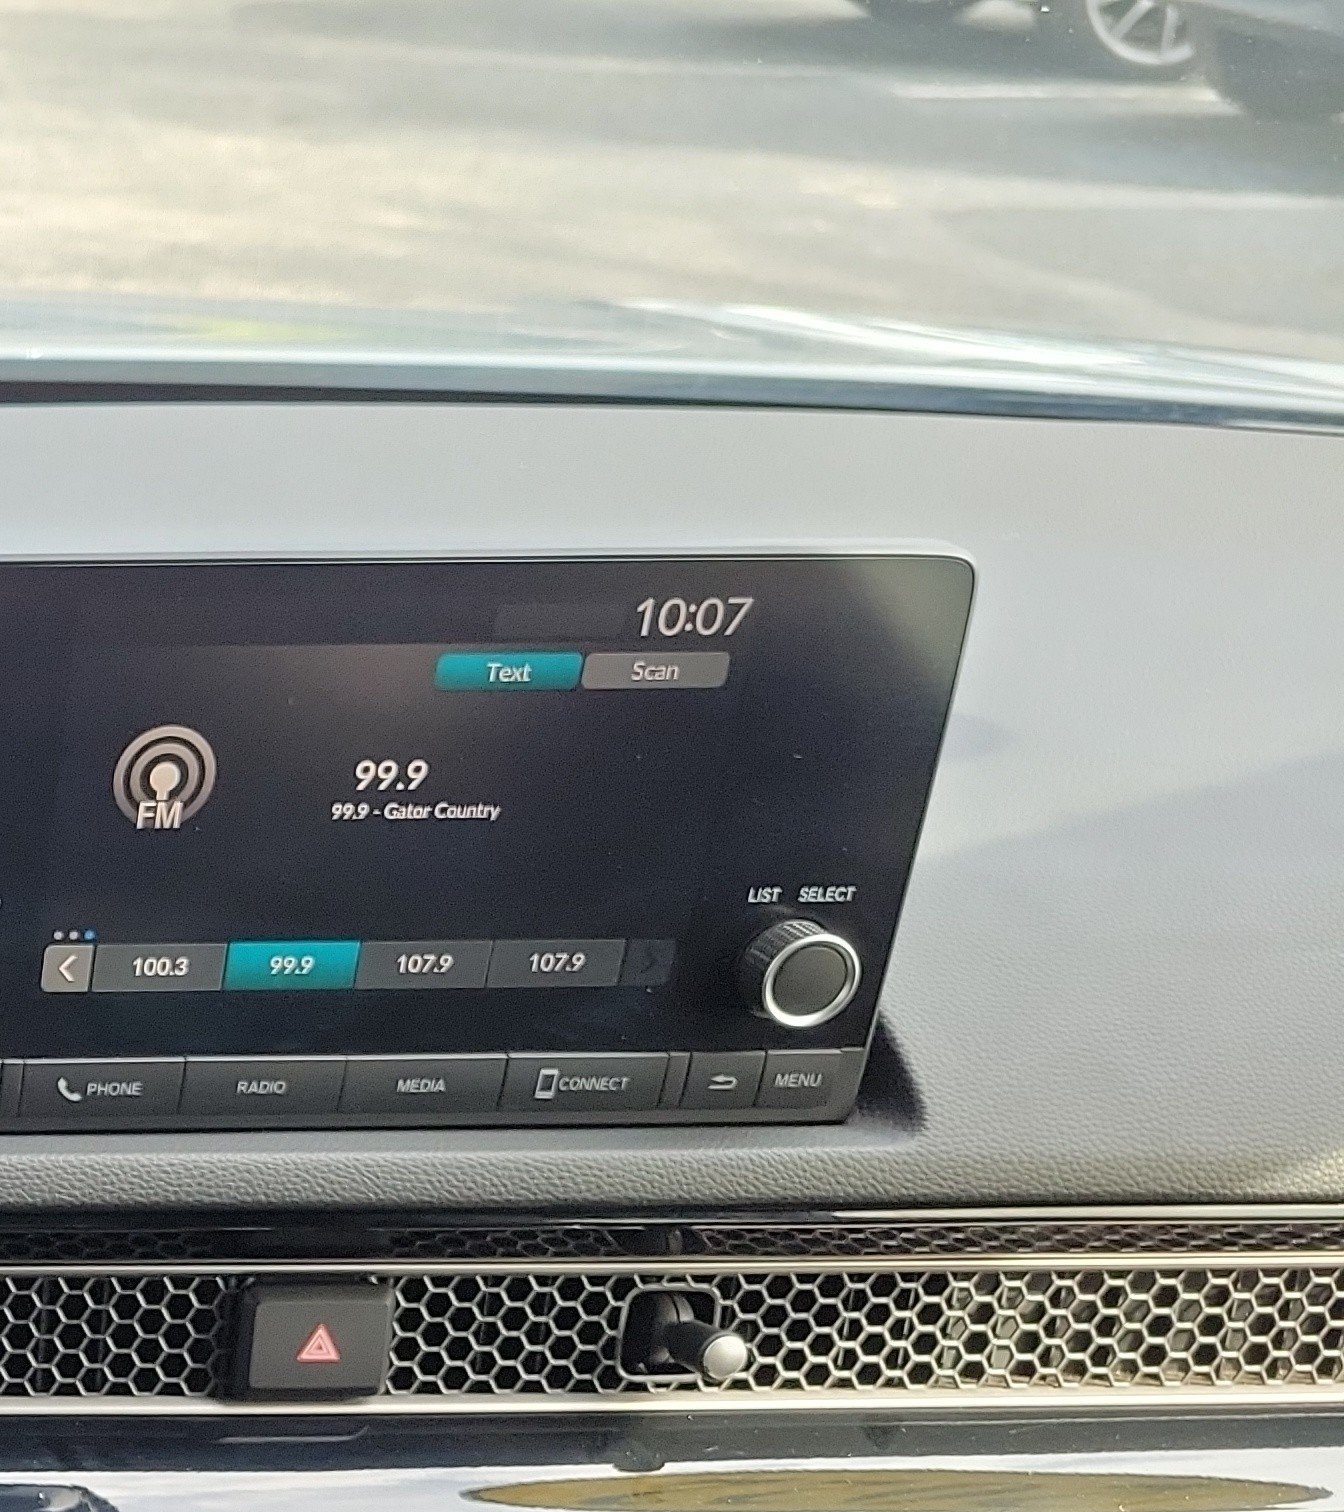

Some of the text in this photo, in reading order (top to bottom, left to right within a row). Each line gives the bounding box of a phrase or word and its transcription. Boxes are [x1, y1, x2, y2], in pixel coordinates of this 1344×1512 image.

[635, 596, 755, 638] 10:07
[486, 661, 533, 684] Text
[630, 660, 680, 682] Scan
[354, 758, 430, 791] 99.9
[136, 800, 184, 830] FM
[331, 803, 371, 821] 99.9
[383, 802, 433, 821] Gator
[434, 802, 501, 822] Country
[747, 885, 784, 903] LIST
[797, 885, 858, 903] SELECT
[131, 956, 189, 977] 100.3
[268, 956, 316, 976] 99.9
[395, 954, 454, 975] 107.9
[528, 952, 587, 973] 107.9
[86, 1081, 144, 1097] PHONE
[236, 1079, 287, 1095] RADIO
[396, 1078, 447, 1094] MEDIA
[558, 1075, 630, 1092] CONNECT
[774, 1073, 823, 1088] MENU
